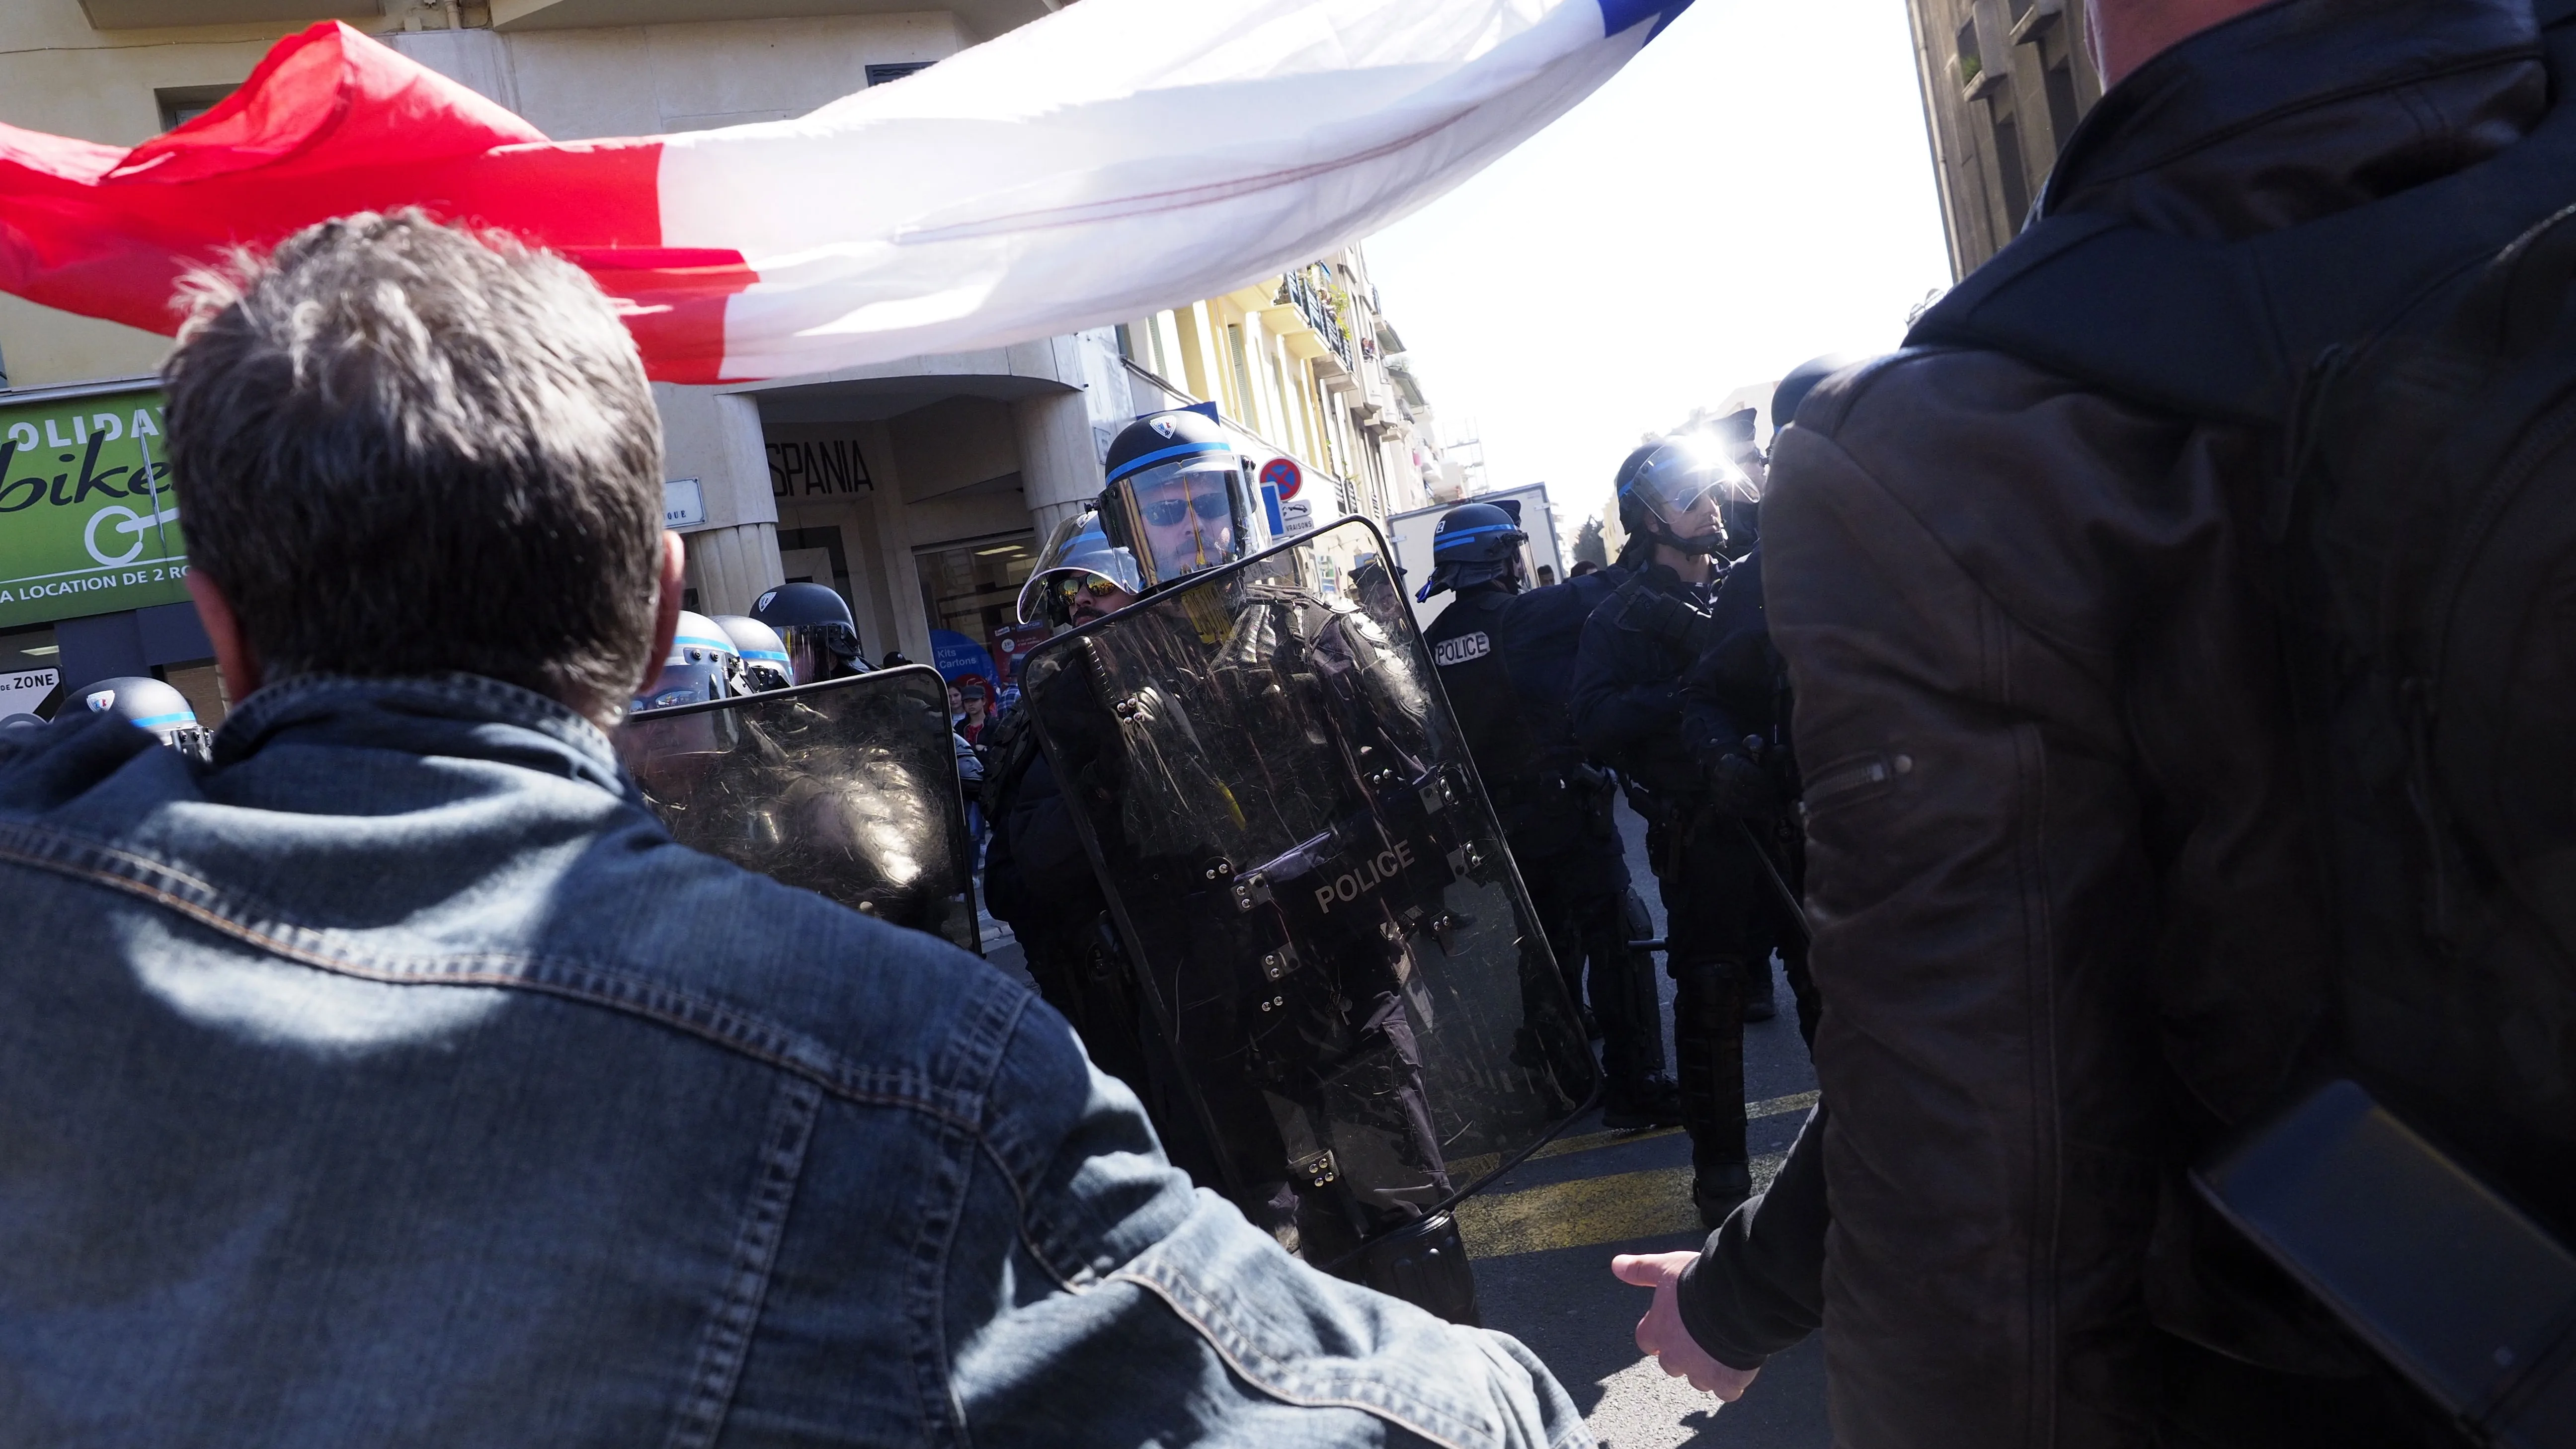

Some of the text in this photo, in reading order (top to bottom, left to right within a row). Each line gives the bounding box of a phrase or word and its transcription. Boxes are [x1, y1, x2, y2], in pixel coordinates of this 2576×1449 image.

[0, 406, 166, 452] OLIDA
[19, 575, 117, 600] LOCATION
[123, 570, 148, 585] DE
[154, 568, 164, 581] 2
[937, 648, 956, 658] Kits
[939, 656, 977, 668] Cartons
[1437, 634, 1487, 663] POLICE
[13, 674, 54, 689] ZONE
[1315, 839, 1415, 914] POLICE
